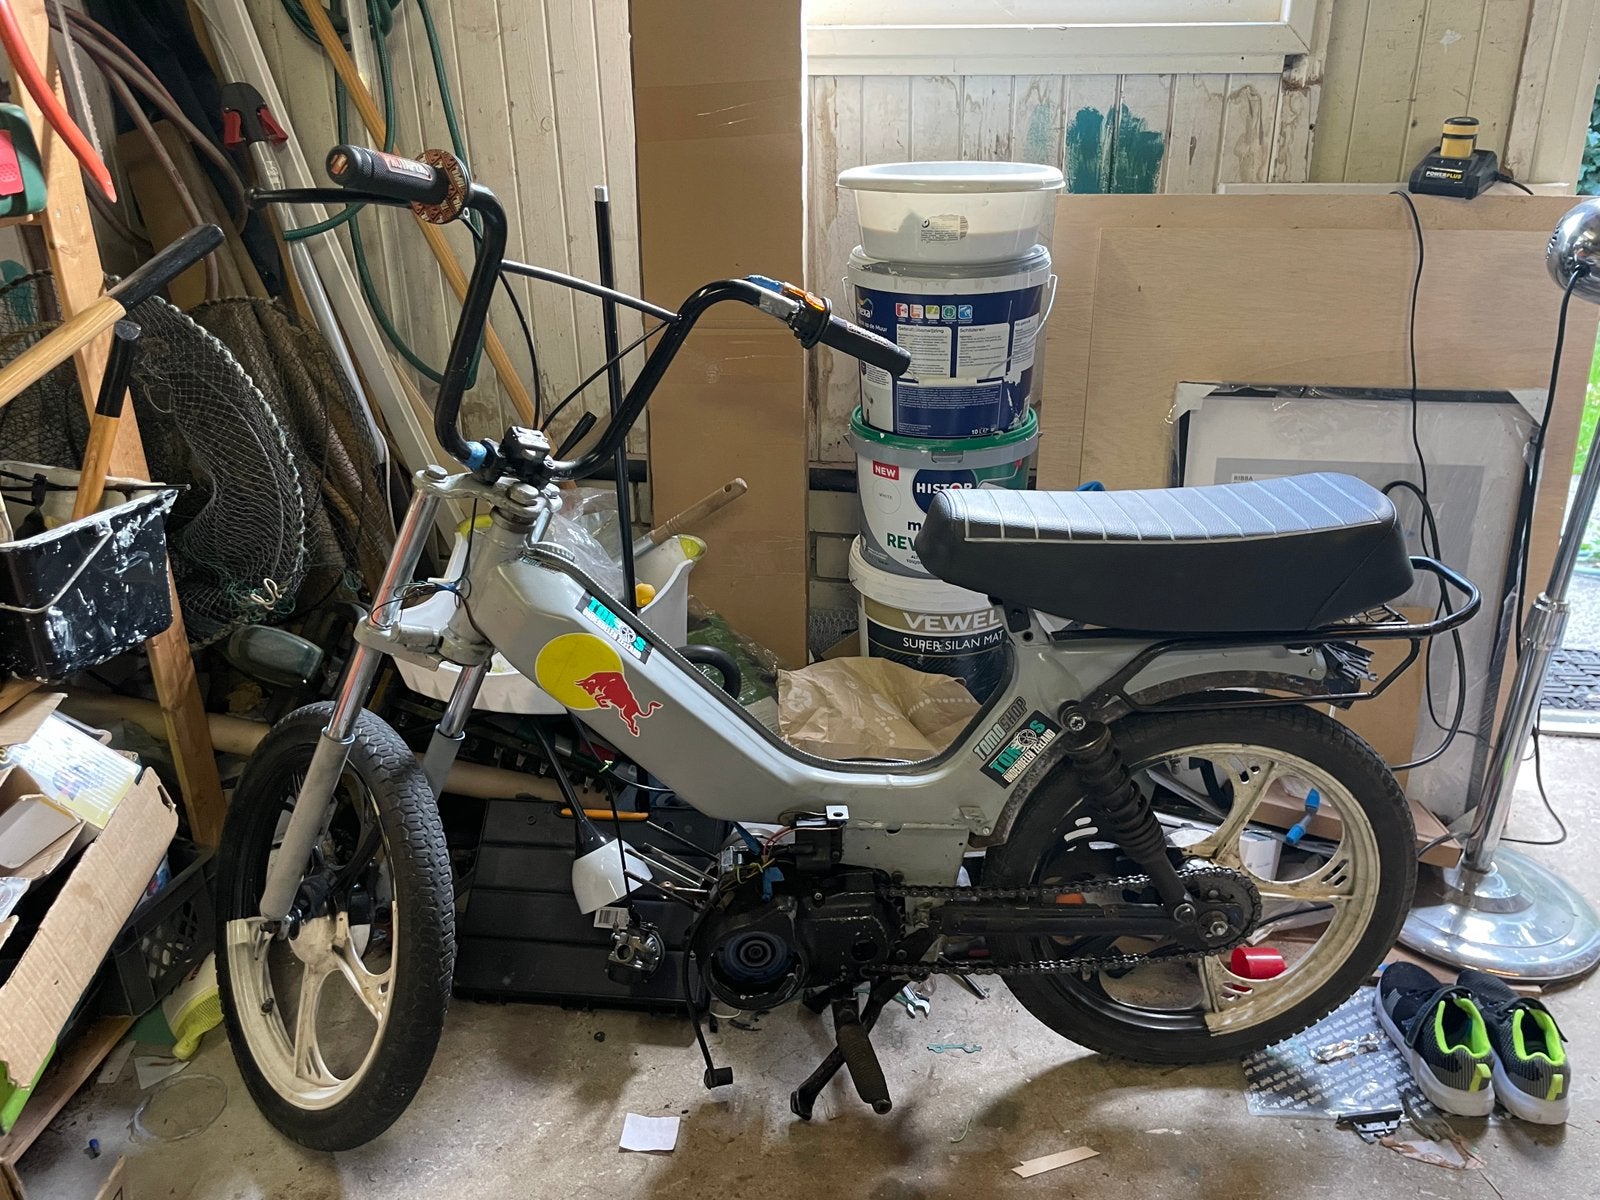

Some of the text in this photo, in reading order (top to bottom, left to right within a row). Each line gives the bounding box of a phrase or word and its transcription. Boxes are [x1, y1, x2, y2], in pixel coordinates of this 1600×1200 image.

[1425, 171, 1462, 179] POWERPLUS
[875, 466, 896, 478] NEW
[902, 637, 941, 651] SUPER
[945, 638, 980, 650] SILAN
